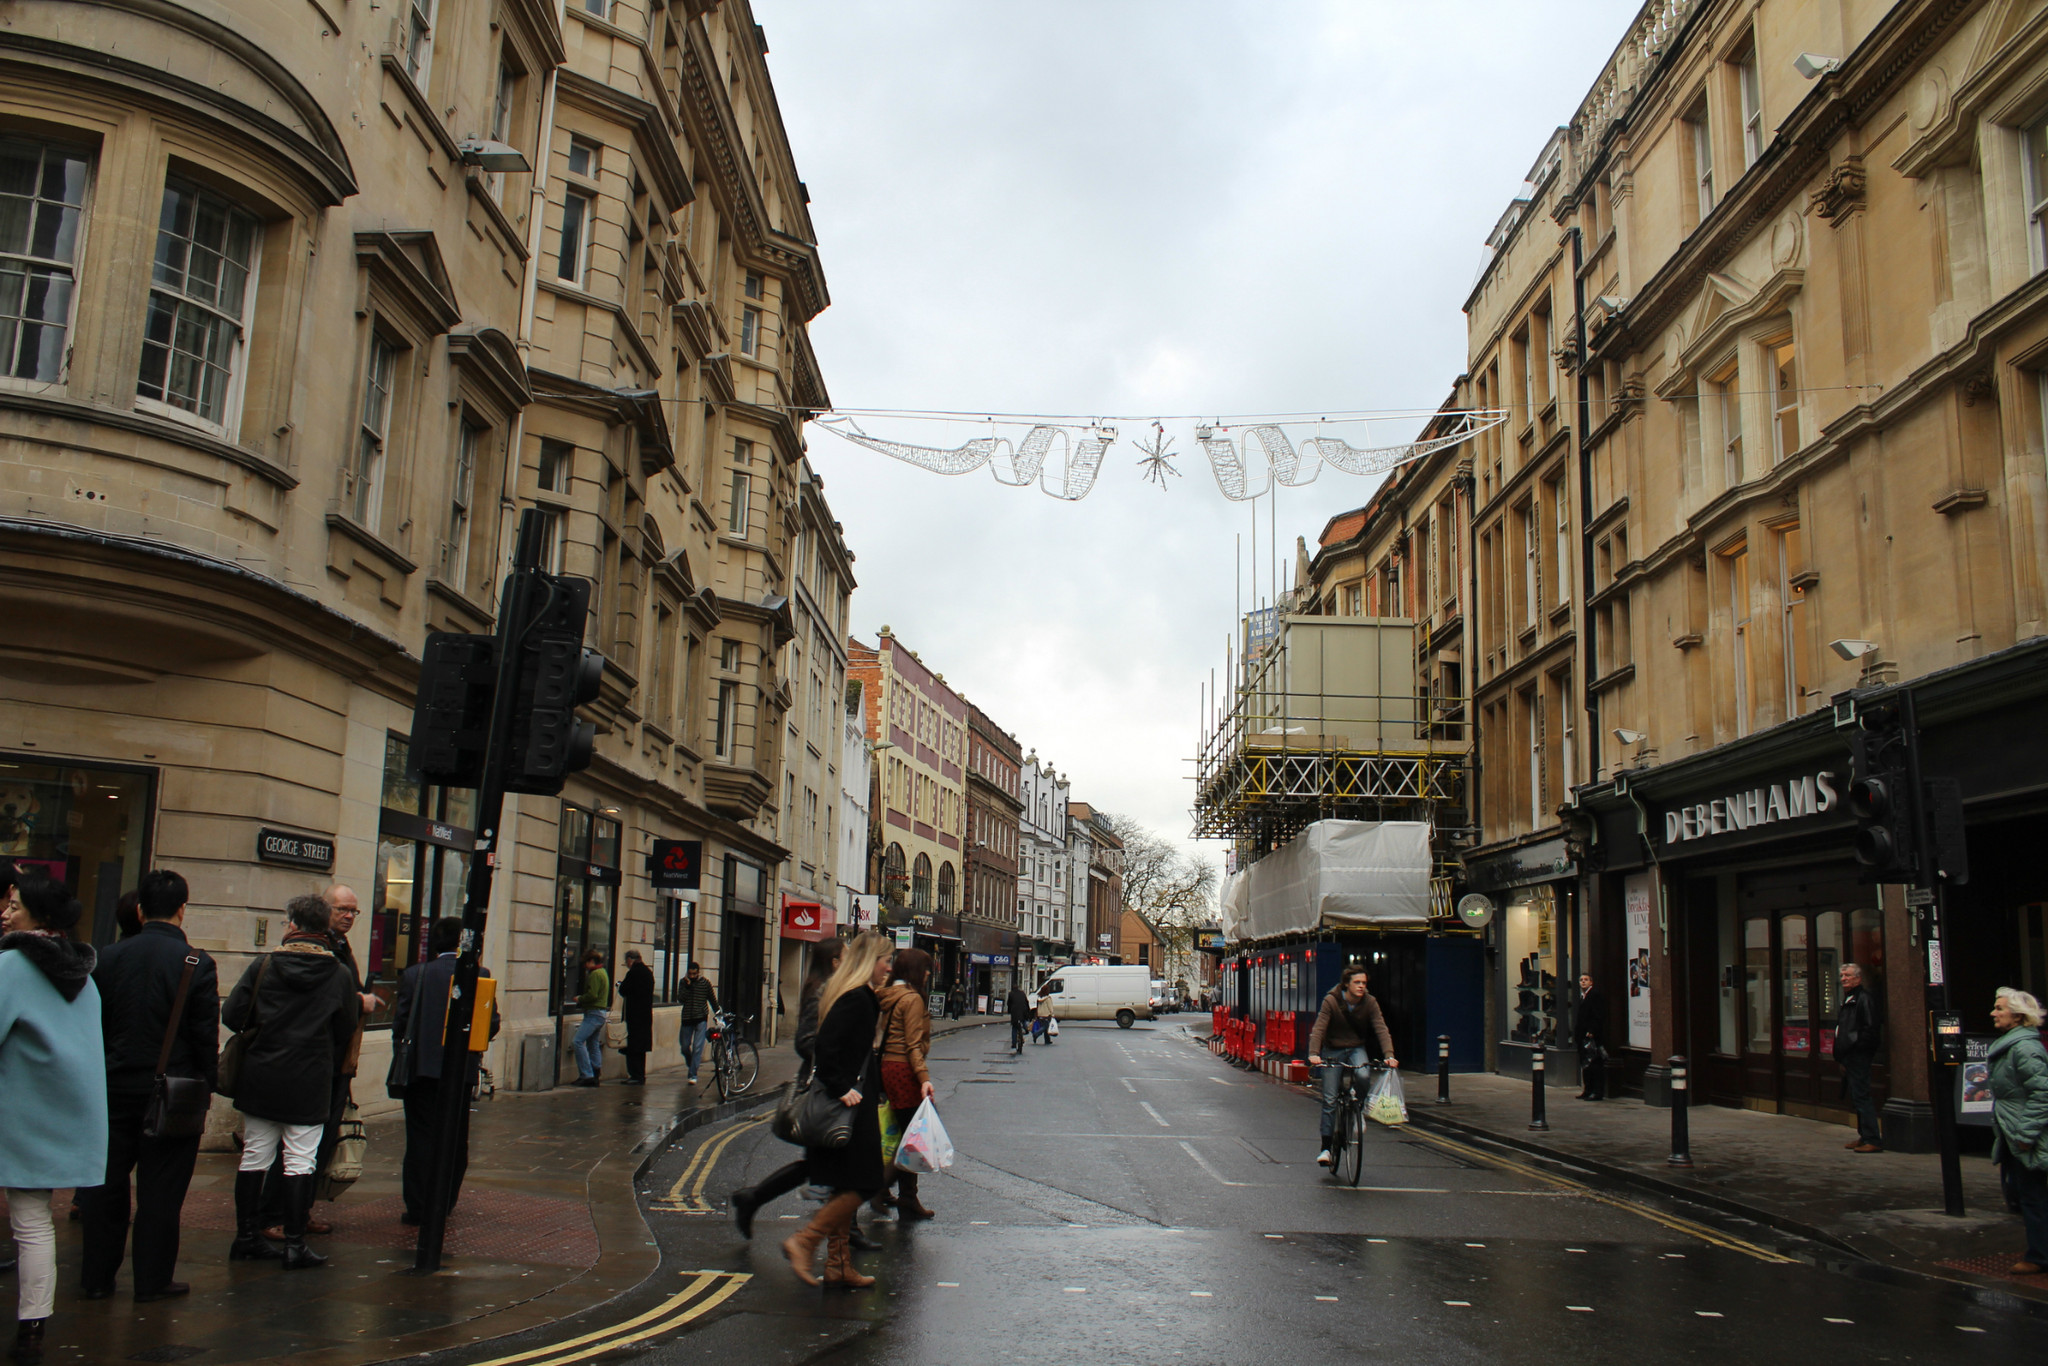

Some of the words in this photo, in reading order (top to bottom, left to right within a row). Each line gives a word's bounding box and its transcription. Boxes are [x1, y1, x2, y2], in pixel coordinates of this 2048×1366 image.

[1250, 628, 1272, 637] AWADS
[1666, 772, 1837, 844] DEBENHAMS
[432, 824, 452, 841] NatWest
[265, 836, 298, 856] GEORGE
[302, 842, 331, 862] STREET
[1966, 1042, 1987, 1050] erfect
